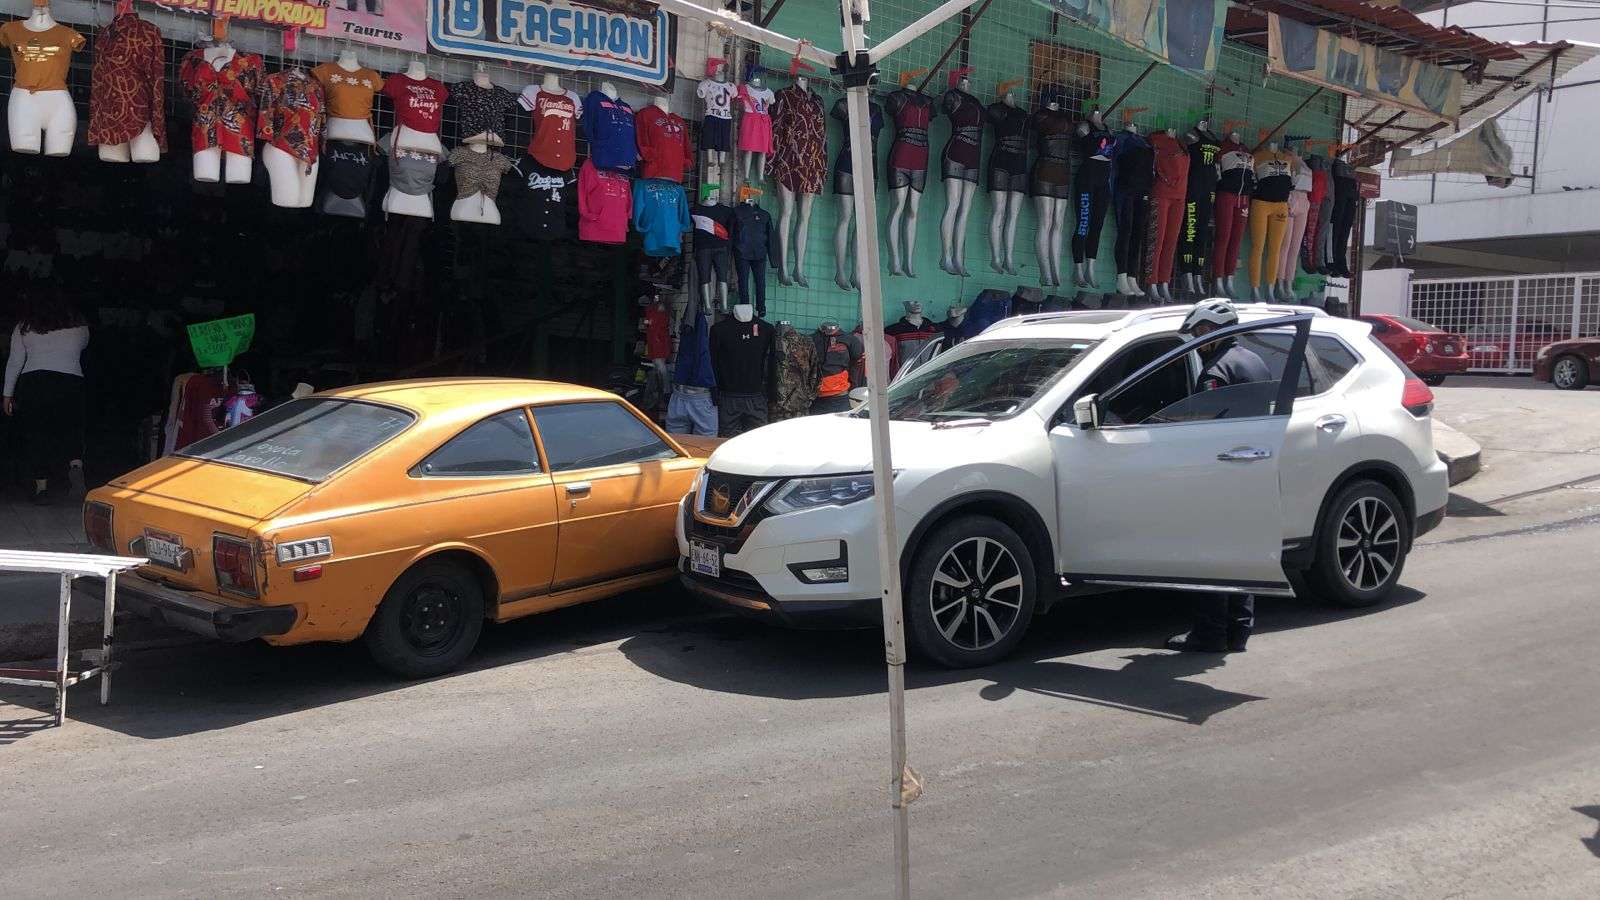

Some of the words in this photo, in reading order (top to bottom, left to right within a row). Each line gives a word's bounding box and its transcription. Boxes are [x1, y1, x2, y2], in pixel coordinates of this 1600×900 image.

[214, 0, 325, 28] TEMPORADA
[342, 21, 403, 41] Taurus
[500, 2, 650, 60] FASHION
[1186, 201, 1197, 242] MONSTER
